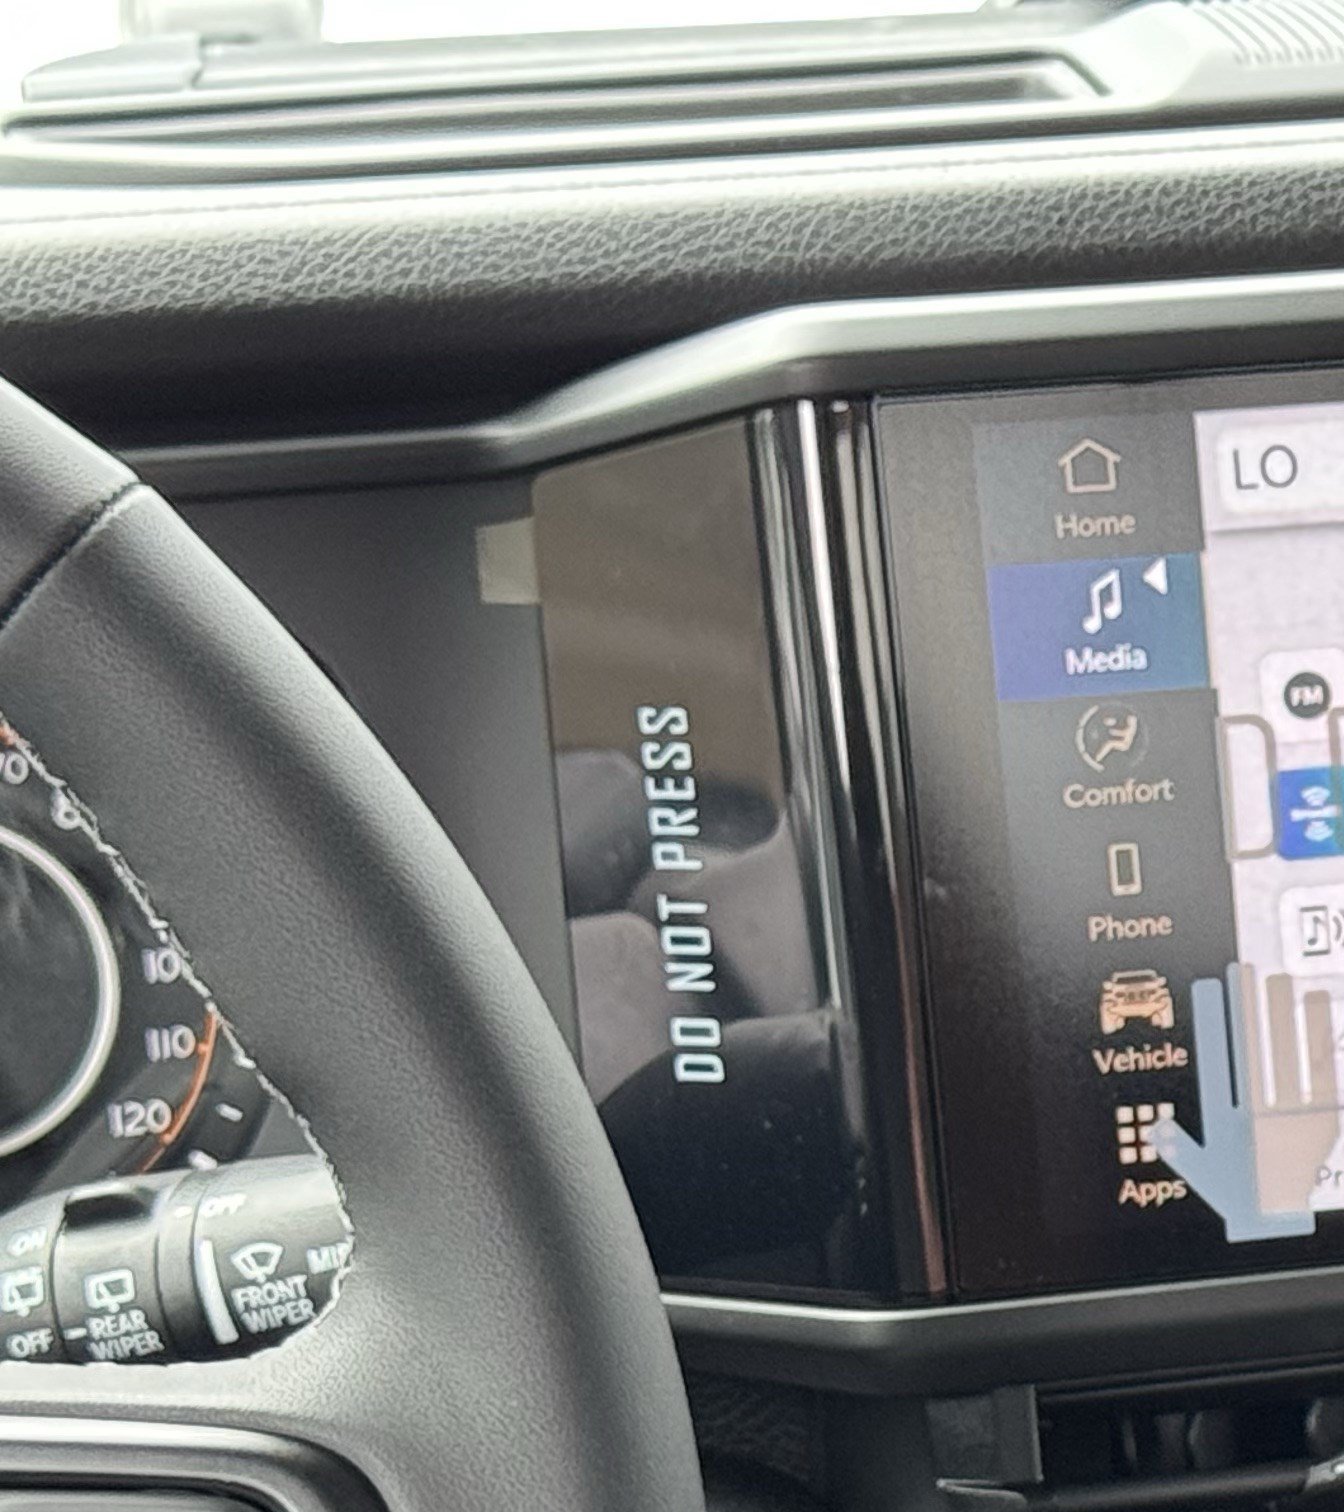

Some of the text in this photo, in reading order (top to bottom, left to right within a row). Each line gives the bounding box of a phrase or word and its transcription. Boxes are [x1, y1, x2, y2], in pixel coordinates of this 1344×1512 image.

[1232, 444, 1298, 490] LO
[1054, 513, 1137, 540] Home
[1064, 643, 1149, 676] Media
[1288, 684, 1325, 708] FM
[1062, 776, 1177, 809] Comfort
[636, 705, 727, 1084] DO NOT PRESS
[1087, 914, 1174, 943] Phone
[143, 1023, 197, 1064] 110
[1093, 1042, 1189, 1076] Vehicle
[107, 1098, 173, 1139] 120
[1117, 1177, 1189, 1209] Apps
[231, 1274, 308, 1313] FRONT
[87, 1308, 149, 1342] REAR
[241, 1298, 318, 1335] WIPER
[6, 1327, 55, 1359] OFF
[87, 1330, 165, 1361] WIPER
